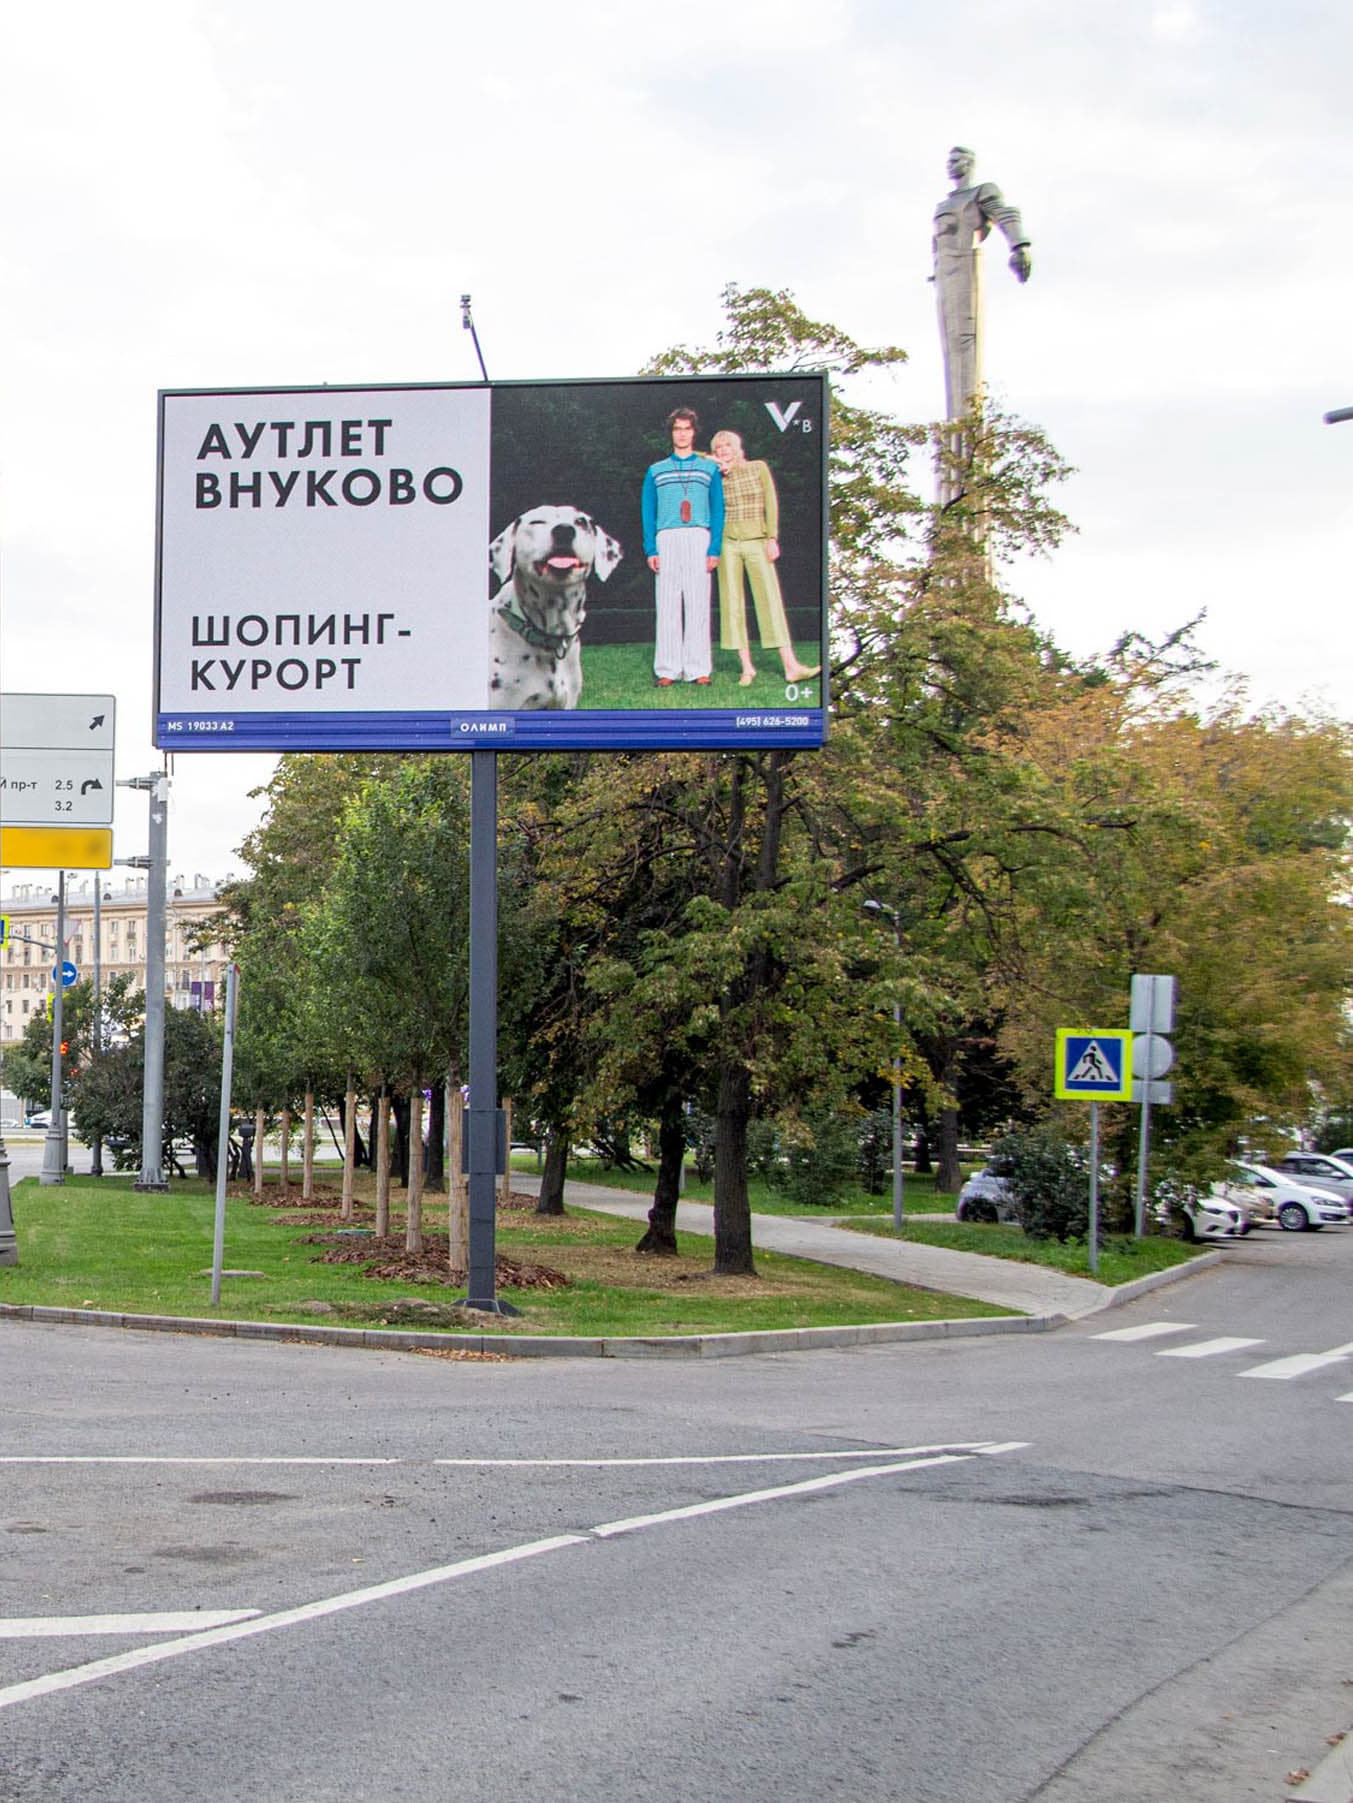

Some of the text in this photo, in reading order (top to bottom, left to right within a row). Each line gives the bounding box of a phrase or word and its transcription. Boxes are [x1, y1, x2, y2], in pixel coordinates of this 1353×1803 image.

[196, 419, 393, 460] АУТЛЕТ
[195, 466, 464, 509] ВНУКОВО
[192, 613, 411, 647] ШОПИНГ-
[191, 658, 361, 691] КУРОРТ
[785, 684, 814, 702] 0+
[168, 721, 235, 731] MS 19033 A2
[460, 722, 507, 733] ОЛИМП
[736, 716, 809, 728] (495) 626-5200
[11, 781, 38, 792] пр-т
[55, 780, 74, 791] 2.5
[54, 801, 74, 812] 3.2
